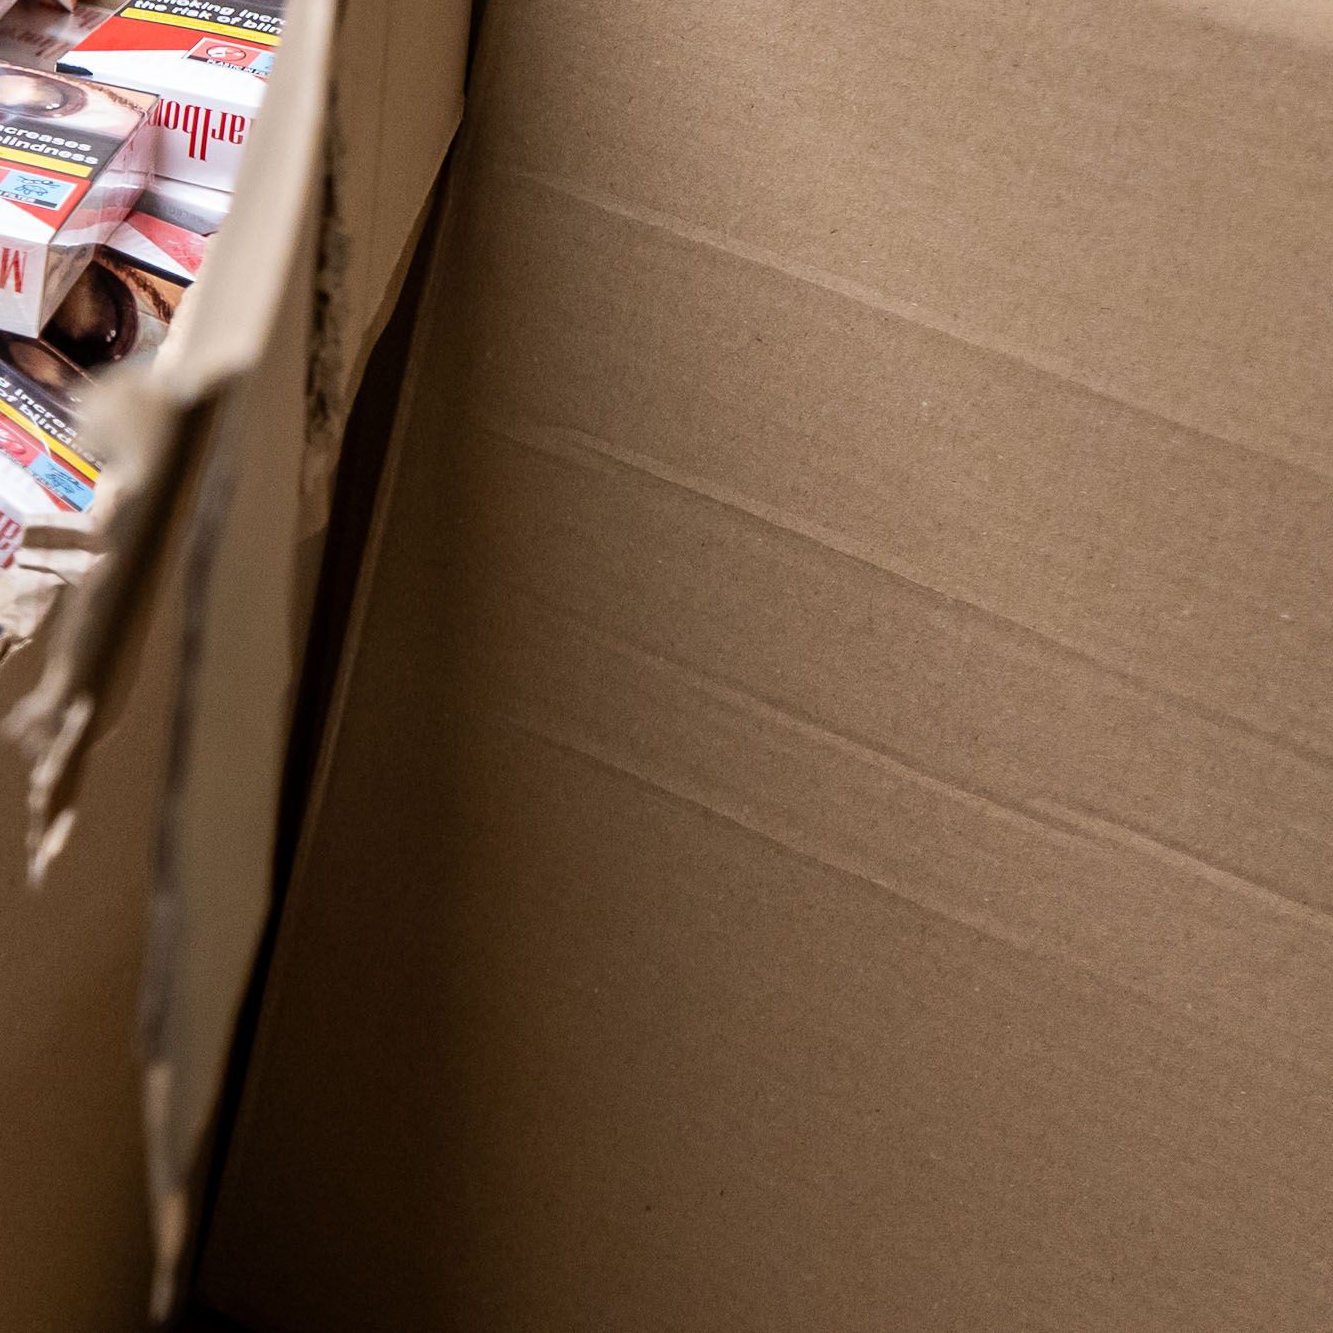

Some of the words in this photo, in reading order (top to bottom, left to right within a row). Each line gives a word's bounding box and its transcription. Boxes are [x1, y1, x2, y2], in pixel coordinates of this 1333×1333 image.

[134, 0, 166, 12] the
[172, 6, 211, 20] risk
[216, 15, 240, 25] of
